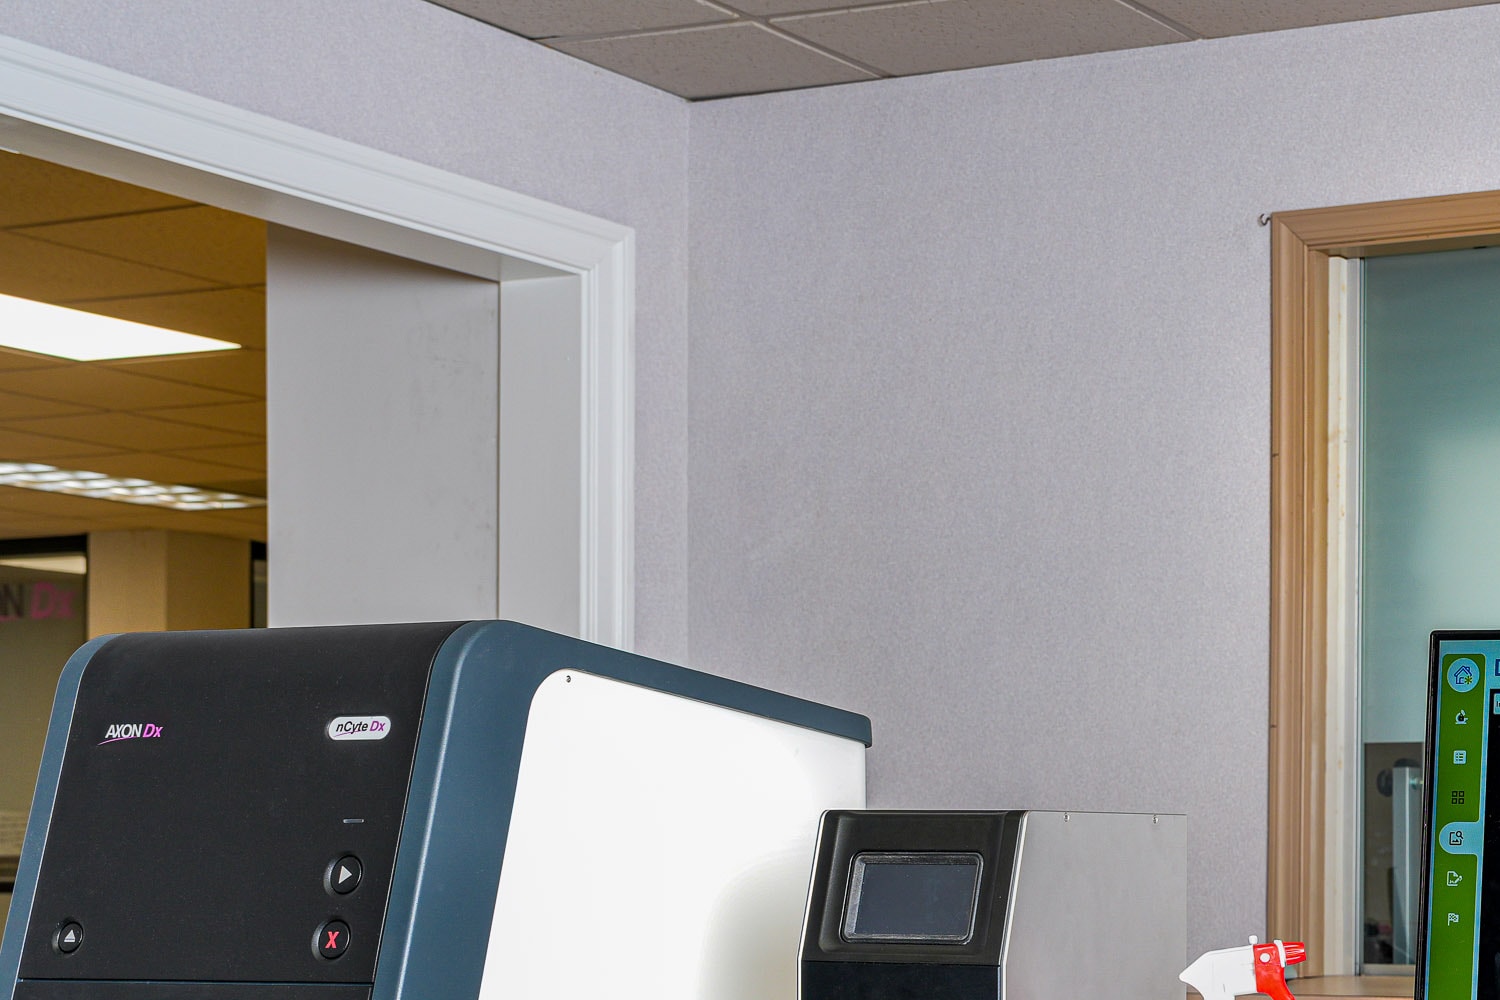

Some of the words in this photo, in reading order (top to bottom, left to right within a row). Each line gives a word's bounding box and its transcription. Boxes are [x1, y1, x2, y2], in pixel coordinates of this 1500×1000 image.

[31, 581, 77, 618] Dx
[105, 724, 142, 738] AXON
[143, 724, 163, 737] Dx
[336, 721, 368, 734] nCyte
[370, 721, 385, 731] Dx
